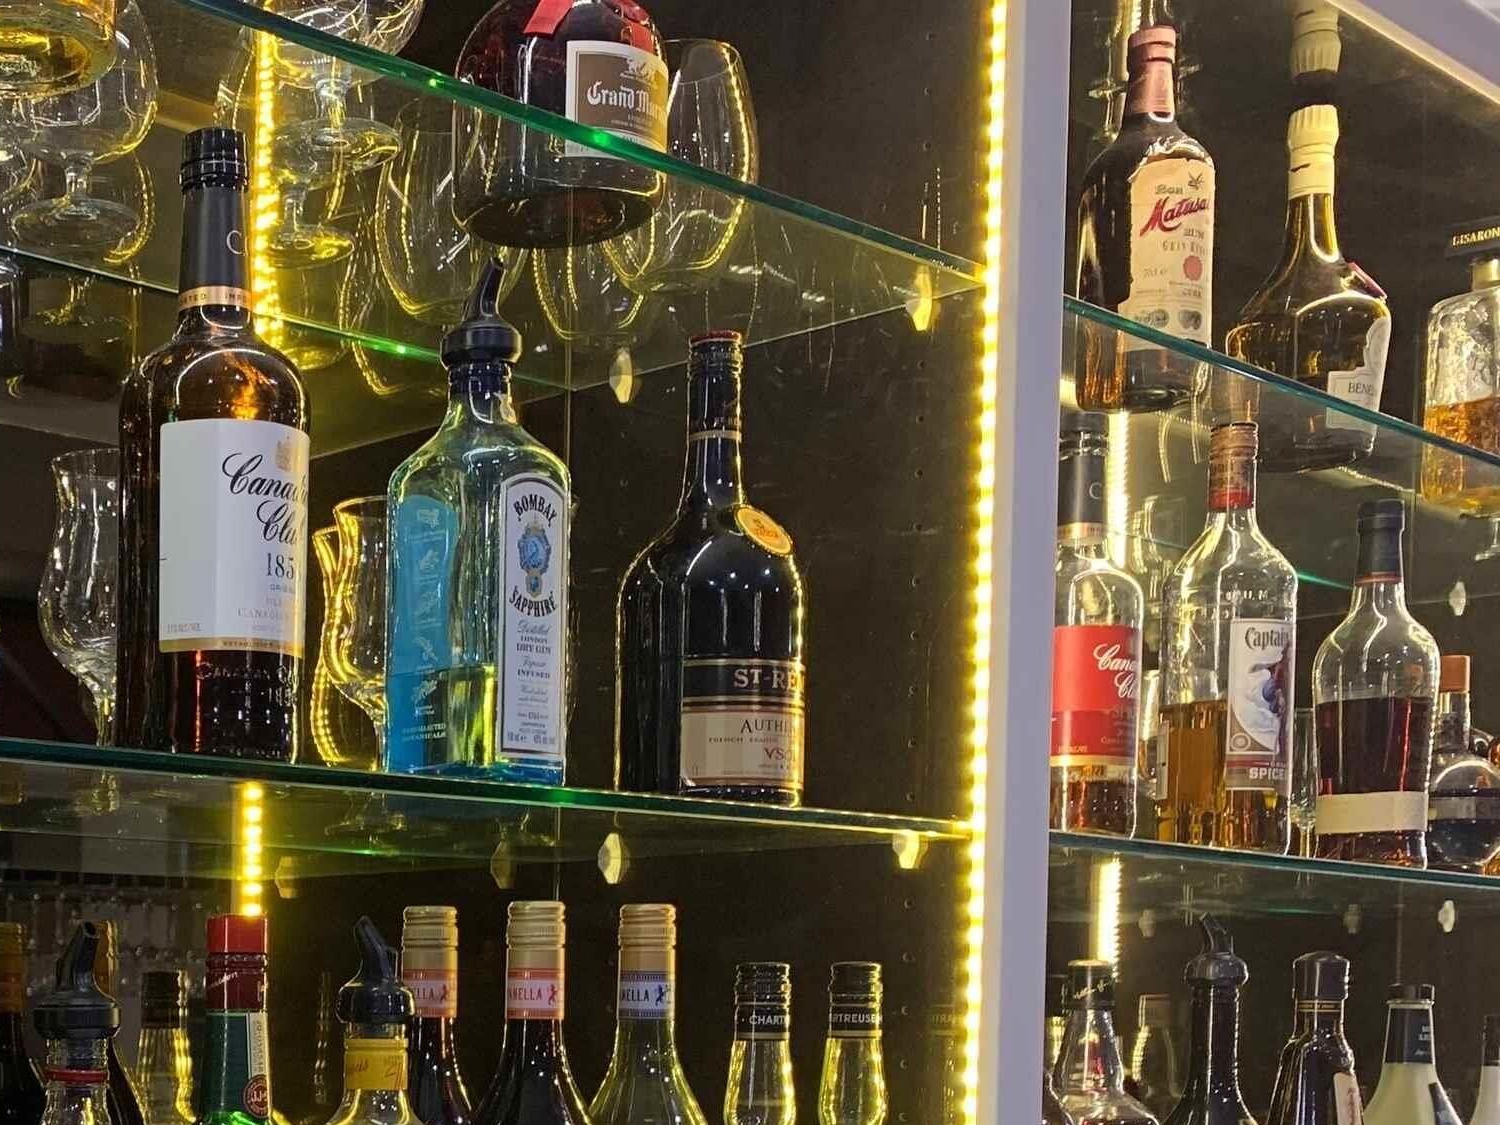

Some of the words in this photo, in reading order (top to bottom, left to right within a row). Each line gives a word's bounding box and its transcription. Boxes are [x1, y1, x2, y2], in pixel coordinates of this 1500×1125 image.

[587, 81, 635, 110] Grand
[513, 493, 558, 528] BOMBAY
[508, 585, 559, 618] SAPPHIRE
[517, 669, 551, 680] INFUSED
